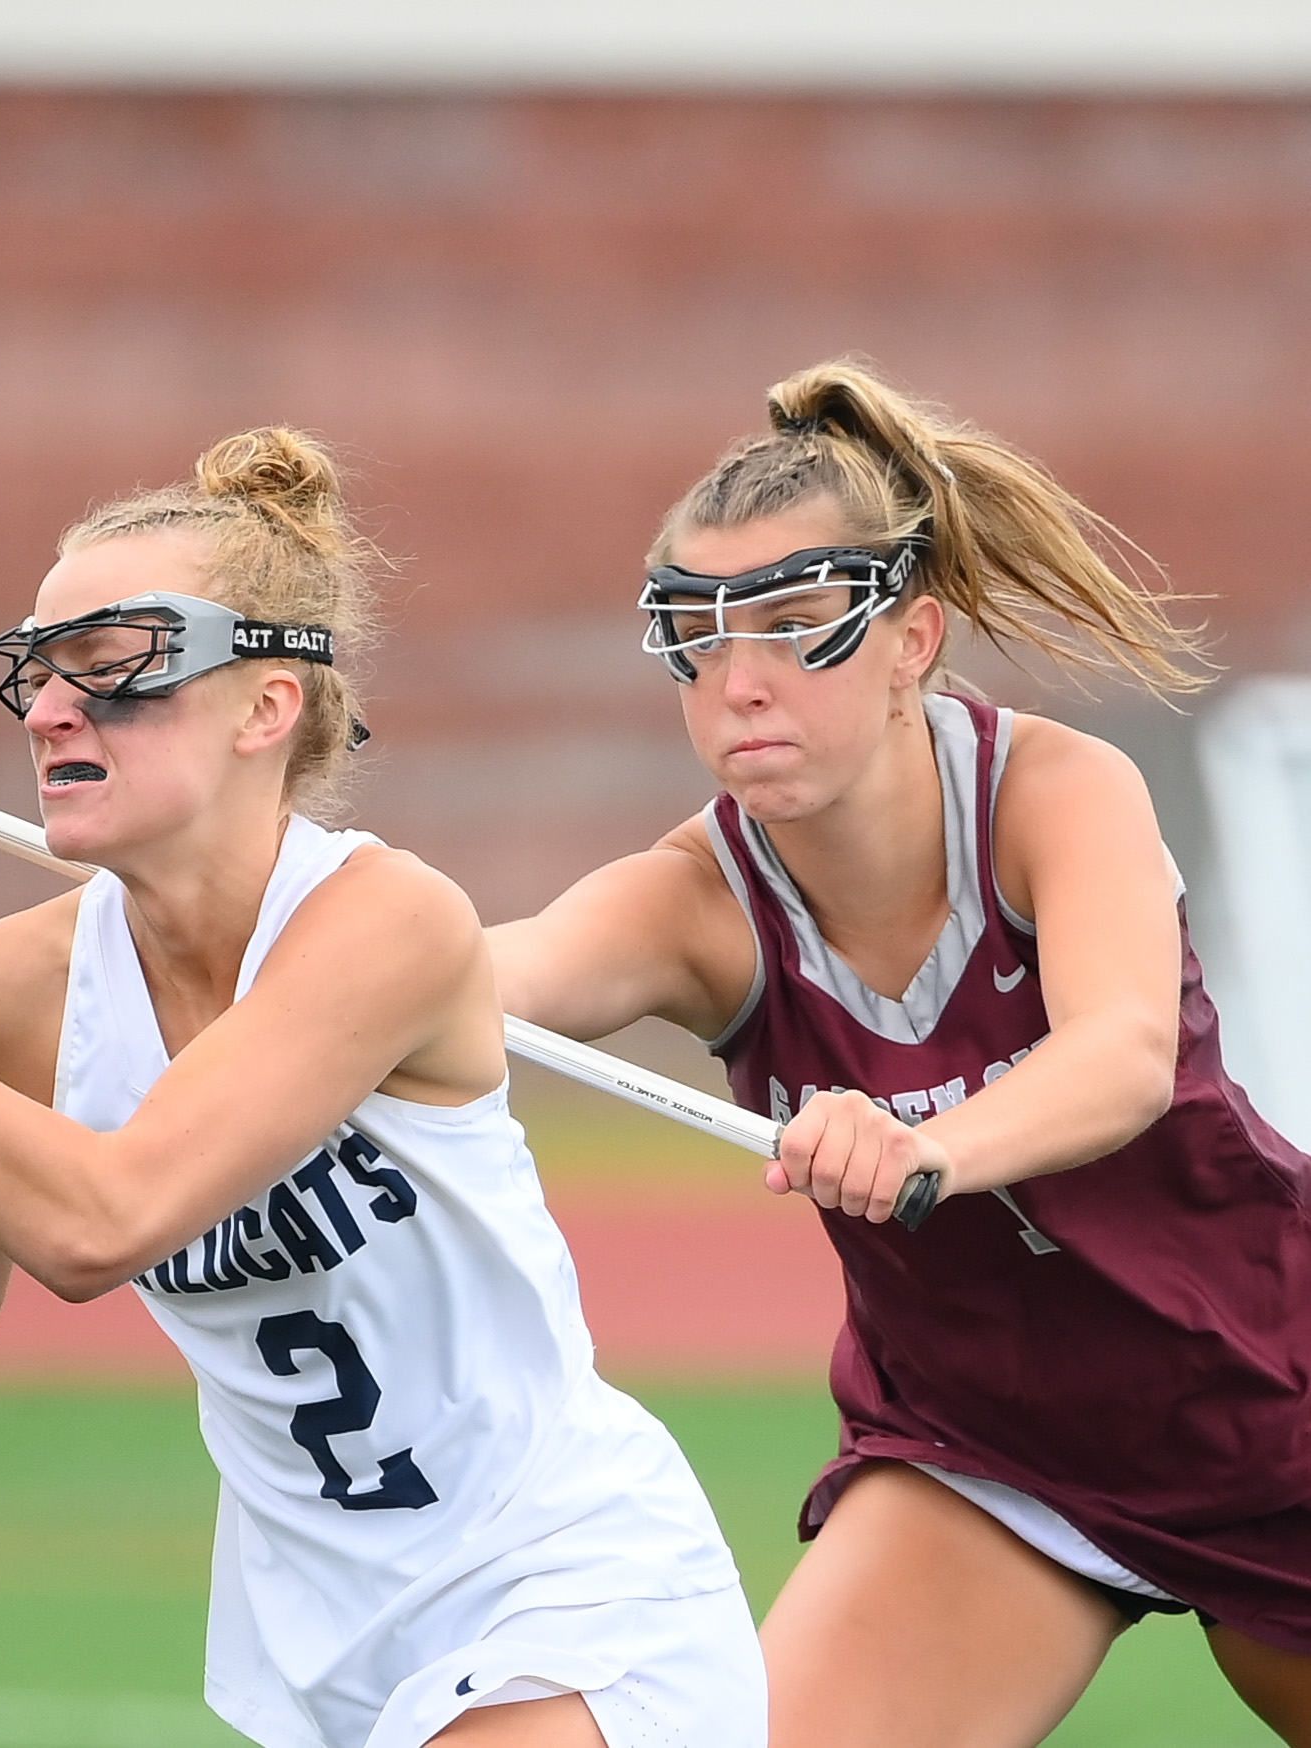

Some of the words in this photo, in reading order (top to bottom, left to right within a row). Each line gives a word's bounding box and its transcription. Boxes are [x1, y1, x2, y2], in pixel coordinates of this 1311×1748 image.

[234, 629, 272, 649] AIT
[284, 630, 326, 651] GAIT
[616, 1080, 668, 1105] DIAMETER
[670, 1101, 713, 1124] MIDSIZE
[255, 1309, 440, 1511] 2
